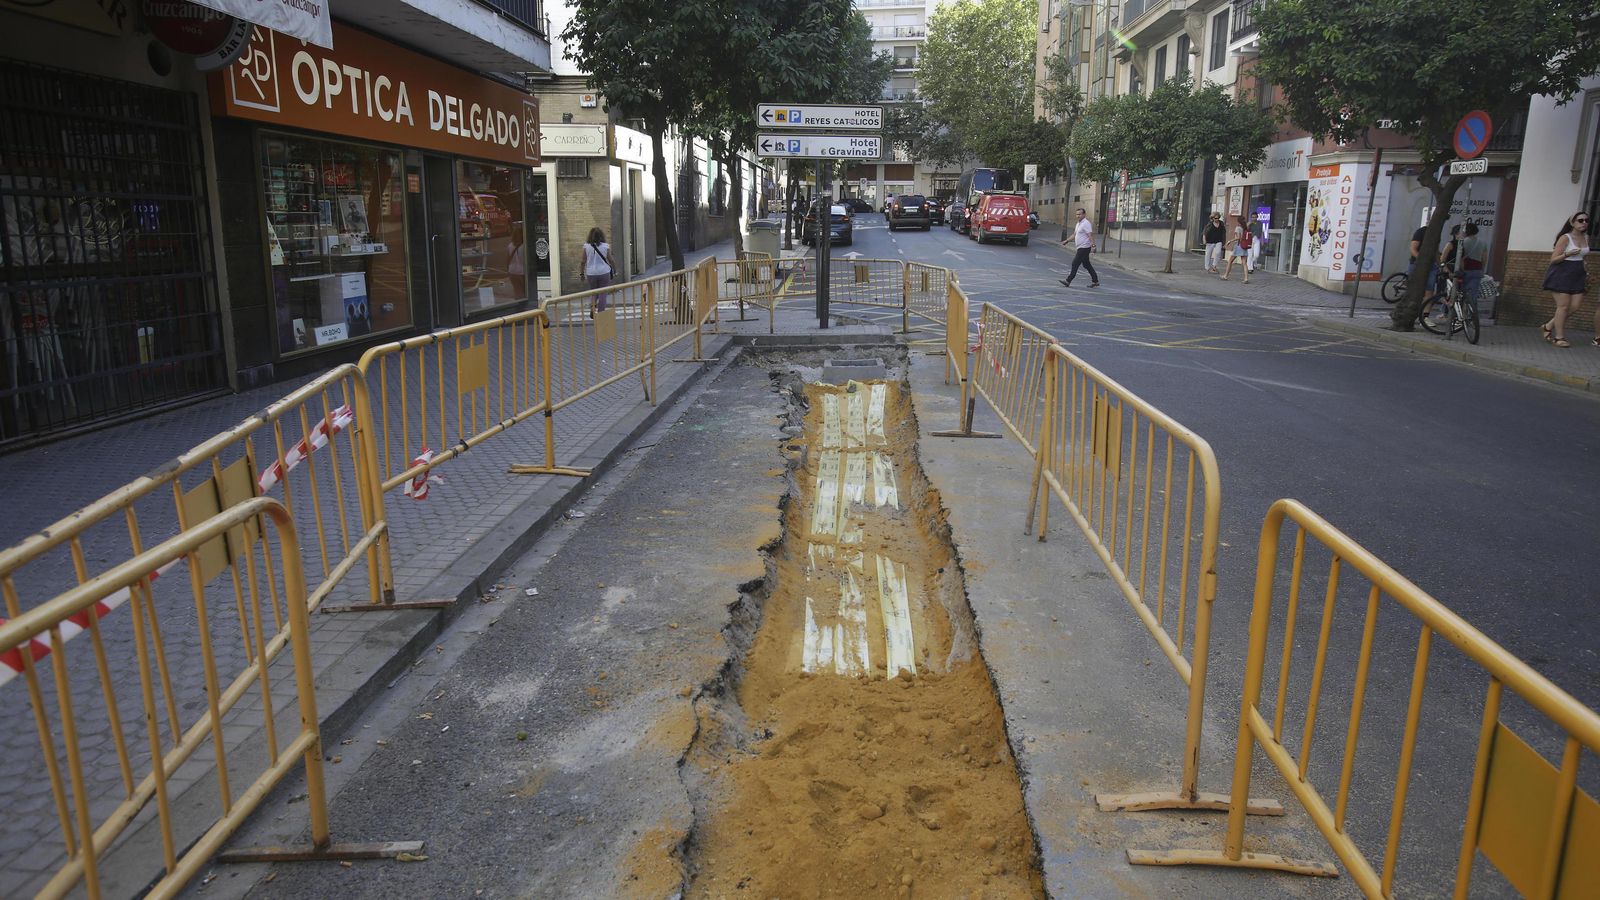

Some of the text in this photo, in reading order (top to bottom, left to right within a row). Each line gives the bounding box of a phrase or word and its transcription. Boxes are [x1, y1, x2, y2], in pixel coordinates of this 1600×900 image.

[218, 39, 240, 60] BAR
[427, 88, 520, 149] DELGADO
[805, 117, 831, 125] REYES
[554, 134, 596, 145] CARREÑO
[850, 138, 878, 147] Hotel
[1453, 161, 1483, 173] INCENDIOS
[1332, 175, 1353, 271] AUDÍFONOS
